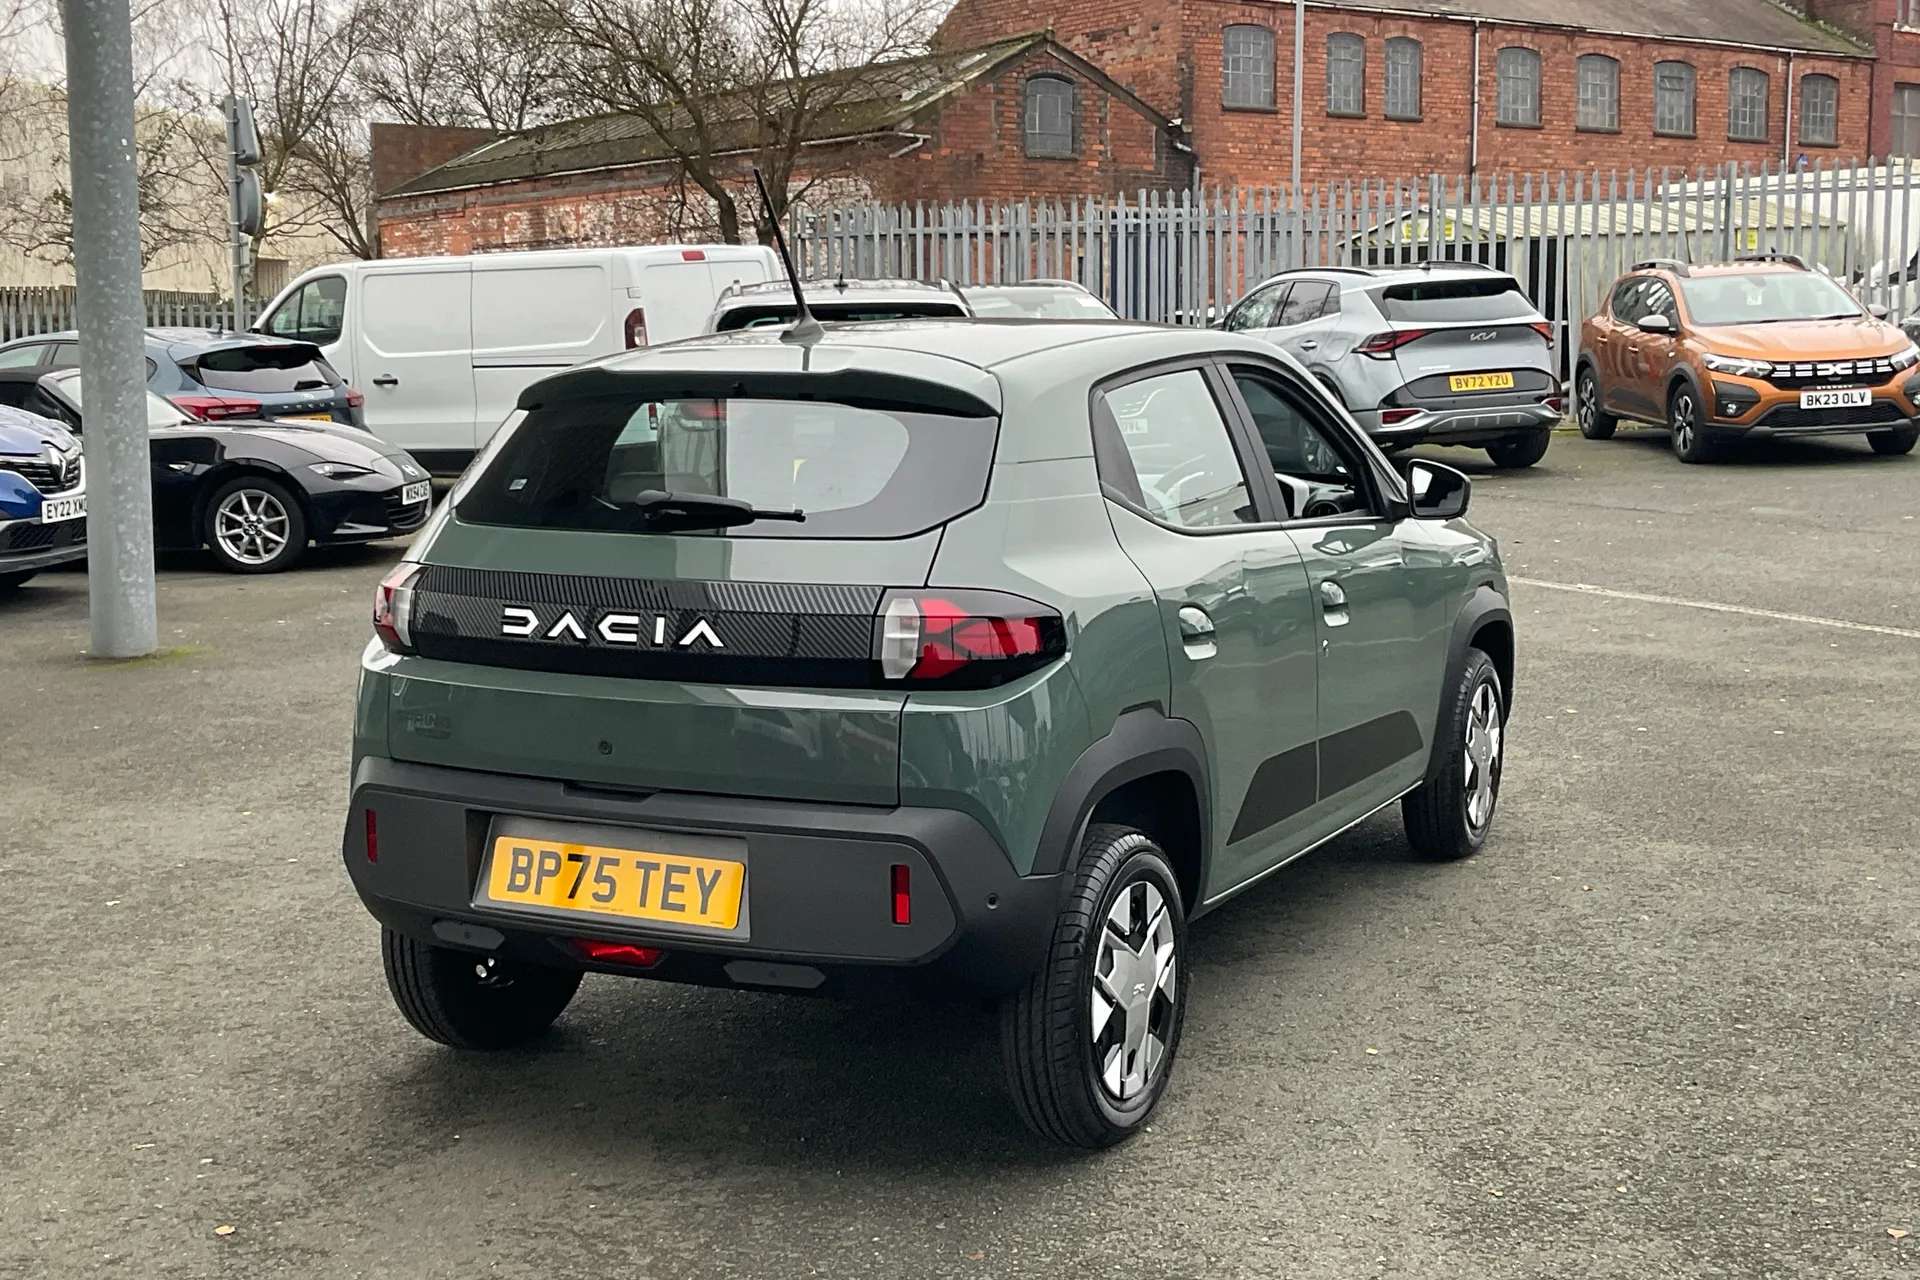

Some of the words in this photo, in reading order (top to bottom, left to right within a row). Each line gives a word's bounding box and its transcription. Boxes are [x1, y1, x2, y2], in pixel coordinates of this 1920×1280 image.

[1455, 377, 1484, 389] BV72
[1487, 374, 1509, 386] YZU
[1806, 393, 1839, 406] BK23
[1842, 391, 1866, 404] OLV
[46, 500, 71, 519] EY22
[502, 607, 725, 648] DACIA
[506, 847, 622, 904] BP75
[635, 860, 722, 915] TEY
